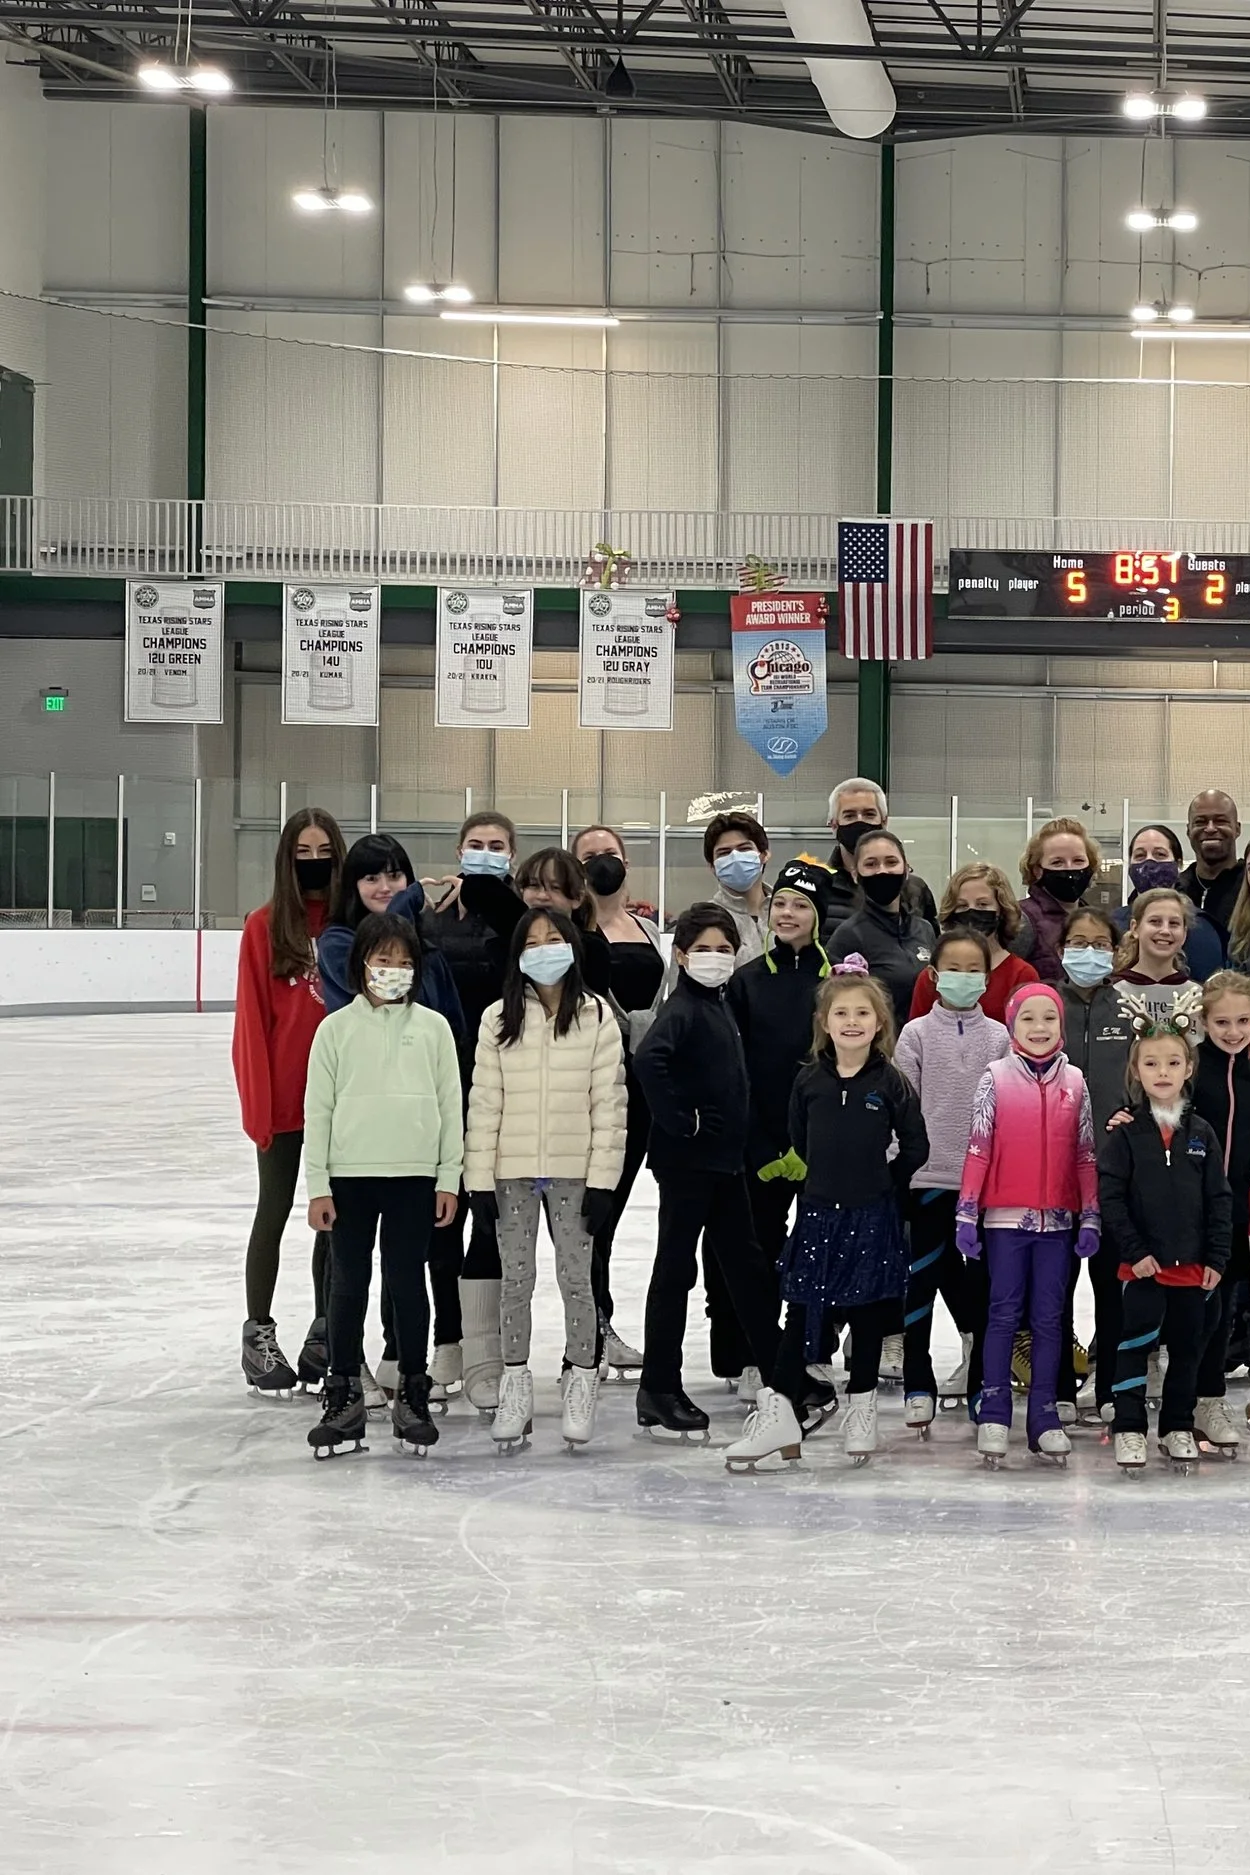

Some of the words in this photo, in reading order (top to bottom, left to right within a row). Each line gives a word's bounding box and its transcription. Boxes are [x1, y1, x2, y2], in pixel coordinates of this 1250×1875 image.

[1053, 555, 1083, 569] Home
[1188, 559, 1226, 571] Guests
[958, 576, 999, 591] penalty
[1008, 578, 1039, 592] player
[1066, 572, 1087, 603] 5
[1206, 574, 1224, 604] 2
[751, 600, 805, 613] PRESIDENT'S
[1120, 604, 1155, 618] period
[1166, 598, 1180, 620] 3
[138, 616, 162, 625] TEXAS
[164, 617, 187, 625] RISING
[189, 618, 212, 626] STARS
[296, 619, 319, 627] TEXAS
[320, 620, 344, 628] RISING
[346, 620, 368, 628] STARS
[746, 613, 776, 626] AWARD
[777, 613, 811, 624] WINNER
[162, 628, 189, 636] LEAGUE
[449, 622, 472, 630] TEXAS
[474, 623, 497, 631] RISING
[498, 624, 521, 632] STARS
[592, 624, 615, 632] TEXAS
[617, 625, 640, 633] RISING
[641, 626, 663, 634] STARS
[318, 630, 345, 638] LEAGUE
[614, 636, 641, 644] LEAGUE
[143, 637, 207, 650] CHAMPIONS
[300, 640, 363, 652] CHAMPIONS
[454, 643, 516, 656] CHAMPIONS
[596, 645, 658, 658] CHAMPIONS
[148, 653, 165, 664] 12U
[168, 654, 202, 665] GREEN
[322, 656, 340, 667] 14U
[476, 659, 493, 670] 10U
[602, 661, 619, 672] 12U
[622, 661, 650, 673] GRAY
[607, 677, 651, 685] ROUGHRIDERS
